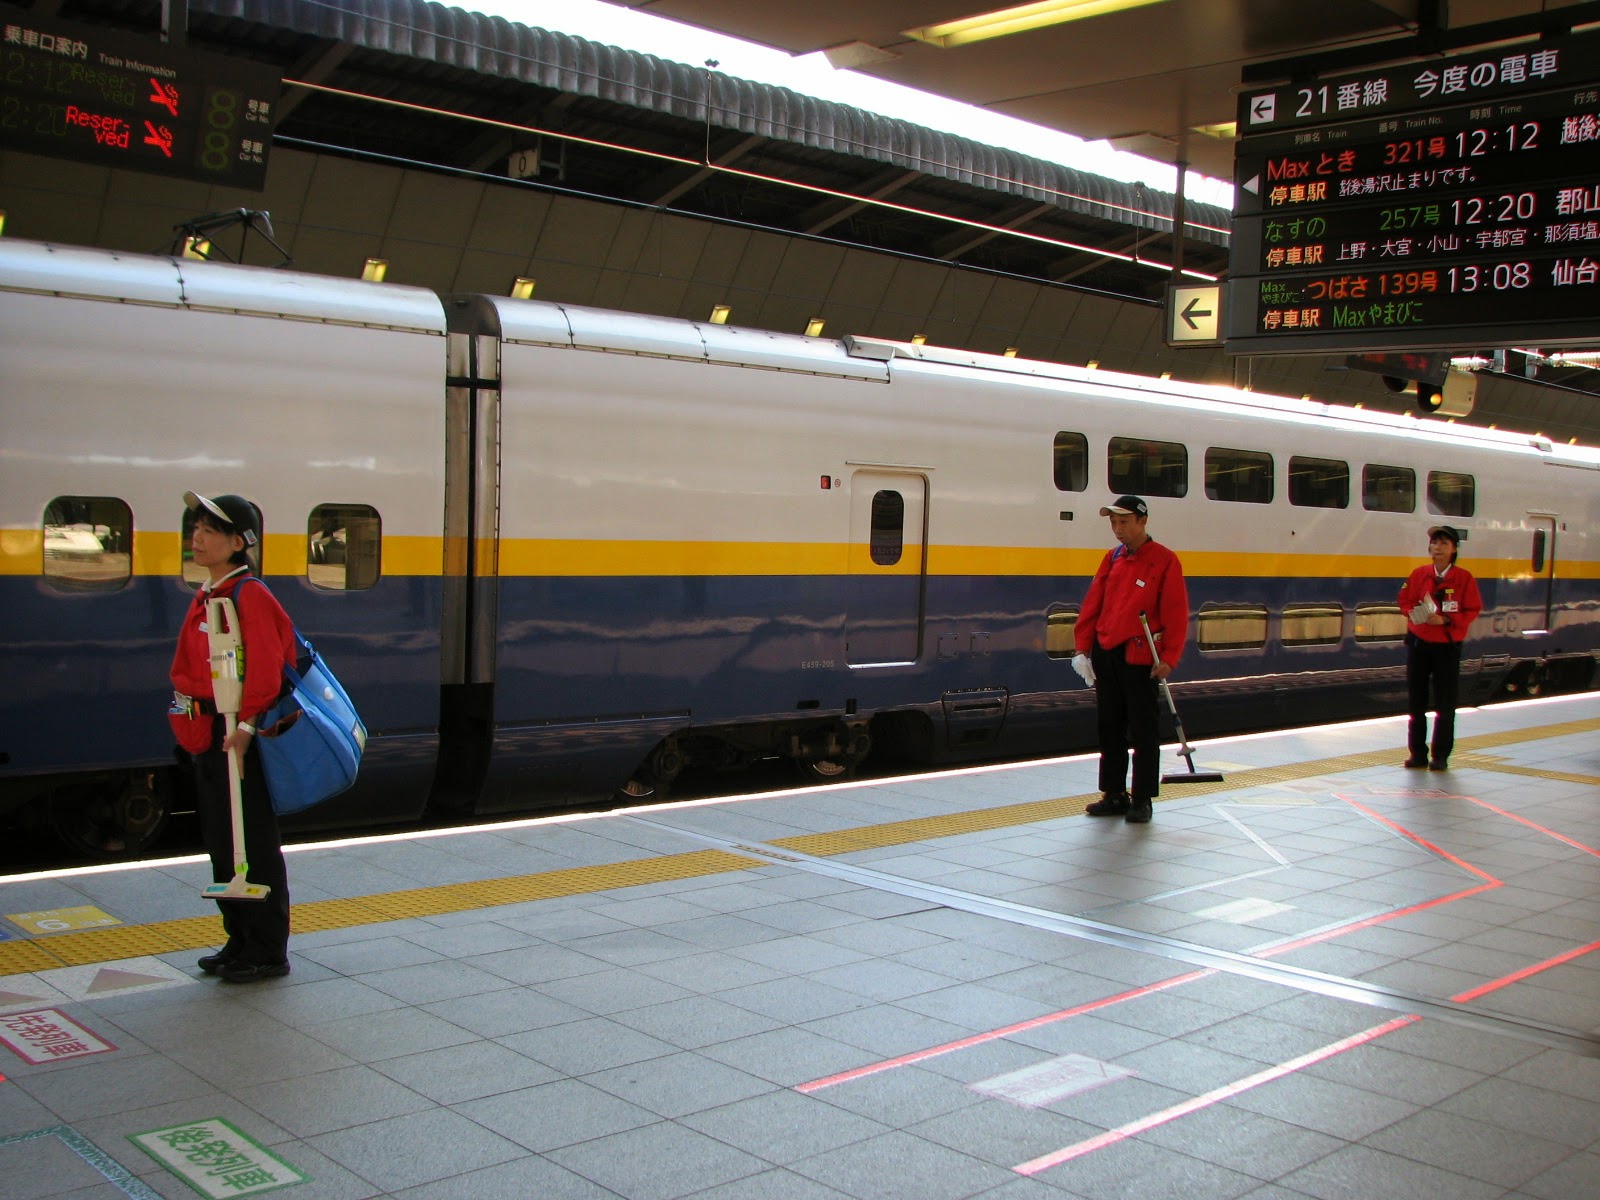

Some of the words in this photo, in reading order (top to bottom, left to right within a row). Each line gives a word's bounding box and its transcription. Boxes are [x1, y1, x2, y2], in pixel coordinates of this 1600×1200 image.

[4, 24, 88, 59] 乗車口案内
[99, 53, 124, 69] Train
[125, 59, 176, 78] Information
[1295, 77, 1388, 118] 21番線
[1413, 49, 1560, 99] 今度の電車
[65, 104, 132, 132] Reser-
[1294, 132, 1320, 145] 列車名
[1328, 128, 1347, 141] Train
[1378, 120, 1398, 133] 番号
[1404, 117, 1427, 130] Train
[1428, 115, 1443, 127] No.
[1469, 107, 1492, 120] 時刻
[1499, 103, 1522, 115] Time
[1573, 91, 1598, 106] 行先
[93, 128, 131, 149] ved
[1316, 150, 1357, 174] とき
[1384, 137, 1447, 165] 321号
[1456, 122, 1541, 158] 12:12
[1560, 112, 1600, 146] 越後
[1268, 181, 1327, 207] 停車駅
[1265, 217, 1327, 243] なすの
[1380, 204, 1441, 232] 257号
[1451, 192, 1537, 226] 12:20
[1555, 185, 1600, 216] 郡山
[1266, 245, 1323, 268] 停車駅
[1261, 281, 1286, 293] Max
[1307, 274, 1369, 299] つばさ
[1378, 270, 1439, 296] 139号
[1448, 262, 1533, 293] 13:08
[1551, 257, 1599, 287] 仙台
[1262, 308, 1320, 330] 停車駅
[36, 919, 71, 931] 6
[1, 1014, 90, 1057] 先発列車
[157, 1126, 278, 1191] 後発列車
